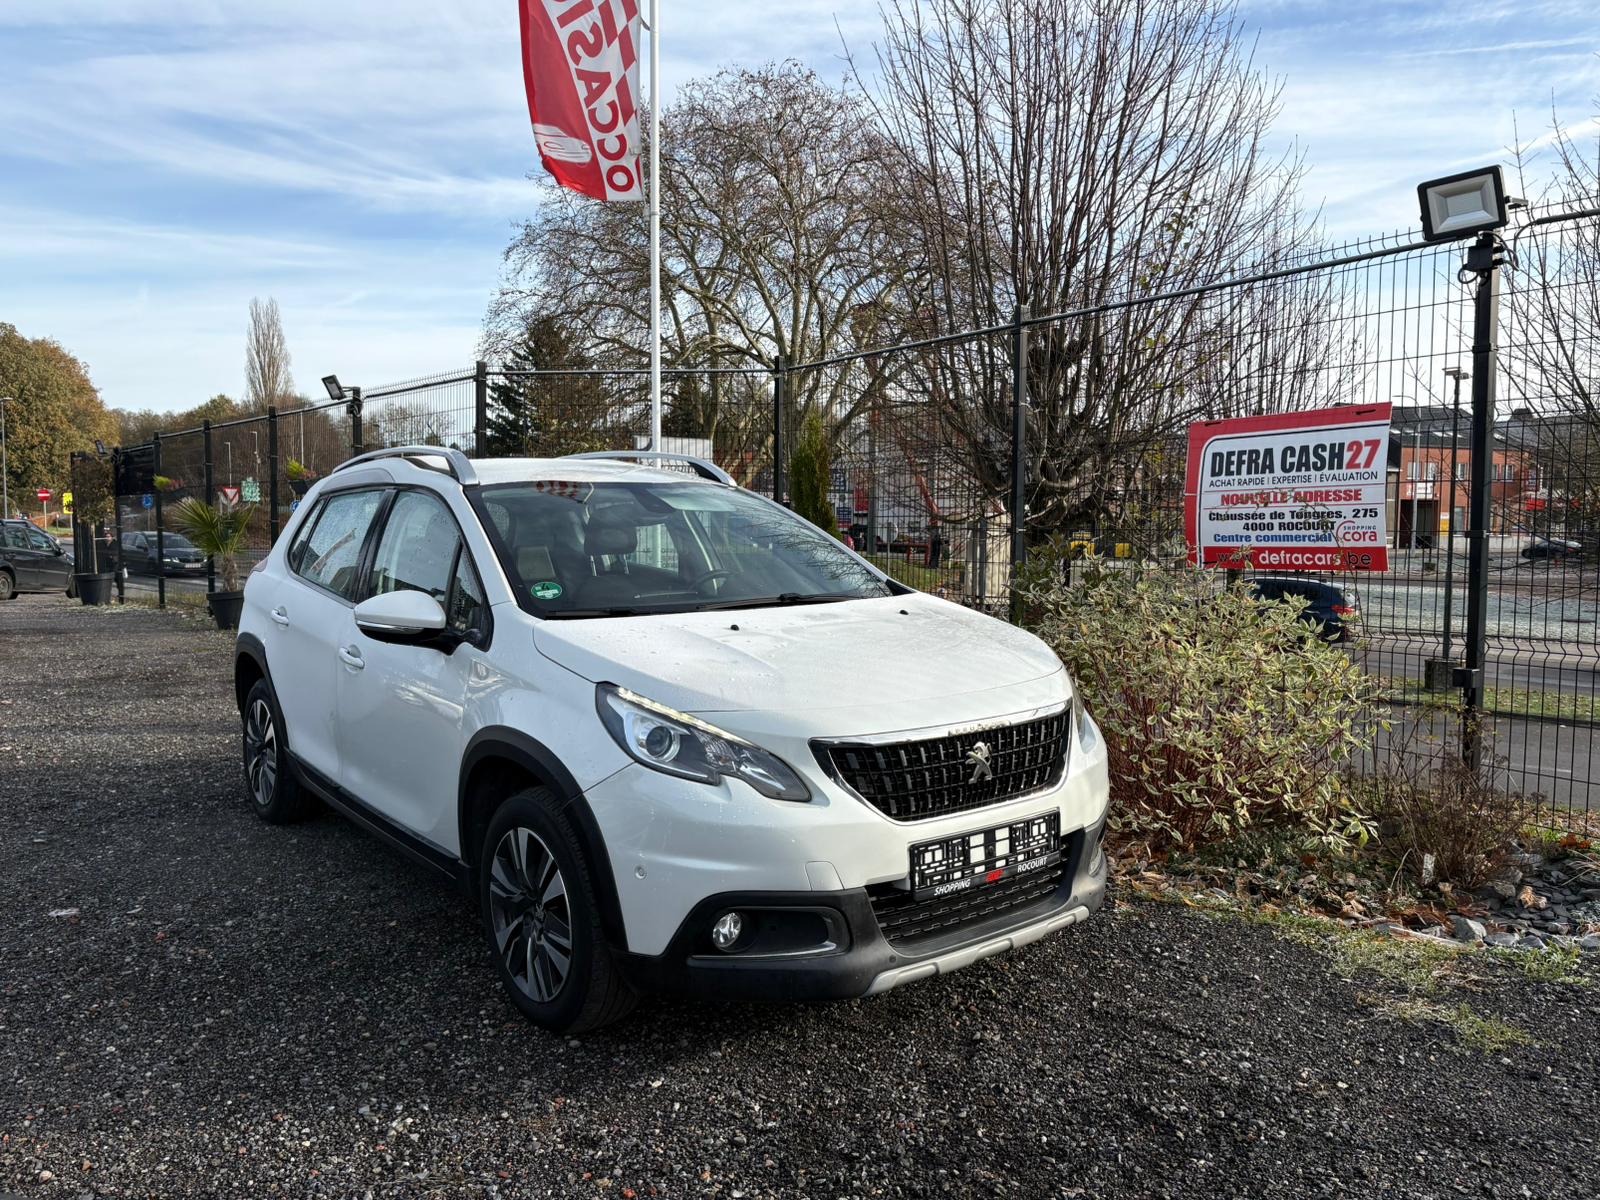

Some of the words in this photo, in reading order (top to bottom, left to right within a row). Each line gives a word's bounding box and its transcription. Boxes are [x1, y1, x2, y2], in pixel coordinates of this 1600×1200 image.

[1210, 447, 1275, 478] DEFRA
[1209, 478, 1237, 488] ACHAT
[1237, 476, 1265, 486] RAPIDE
[1272, 474, 1312, 485] EXPERTISE
[1319, 471, 1378, 483] ÉVALUATION
[1292, 488, 1362, 503] ADRESSE
[1209, 511, 1266, 522] Chaussée
[1269, 510, 1285, 520] de
[1352, 508, 1378, 518] 275
[1242, 522, 1274, 531] 4000
[1278, 521, 1337, 531] ROCOURT
[1214, 533, 1251, 543] Centre
[1255, 532, 1333, 543] commercial
[1343, 530, 1377, 542] cora
[934, 878, 971, 897] SHOPPING
[1017, 856, 1048, 874] ROCOURT
